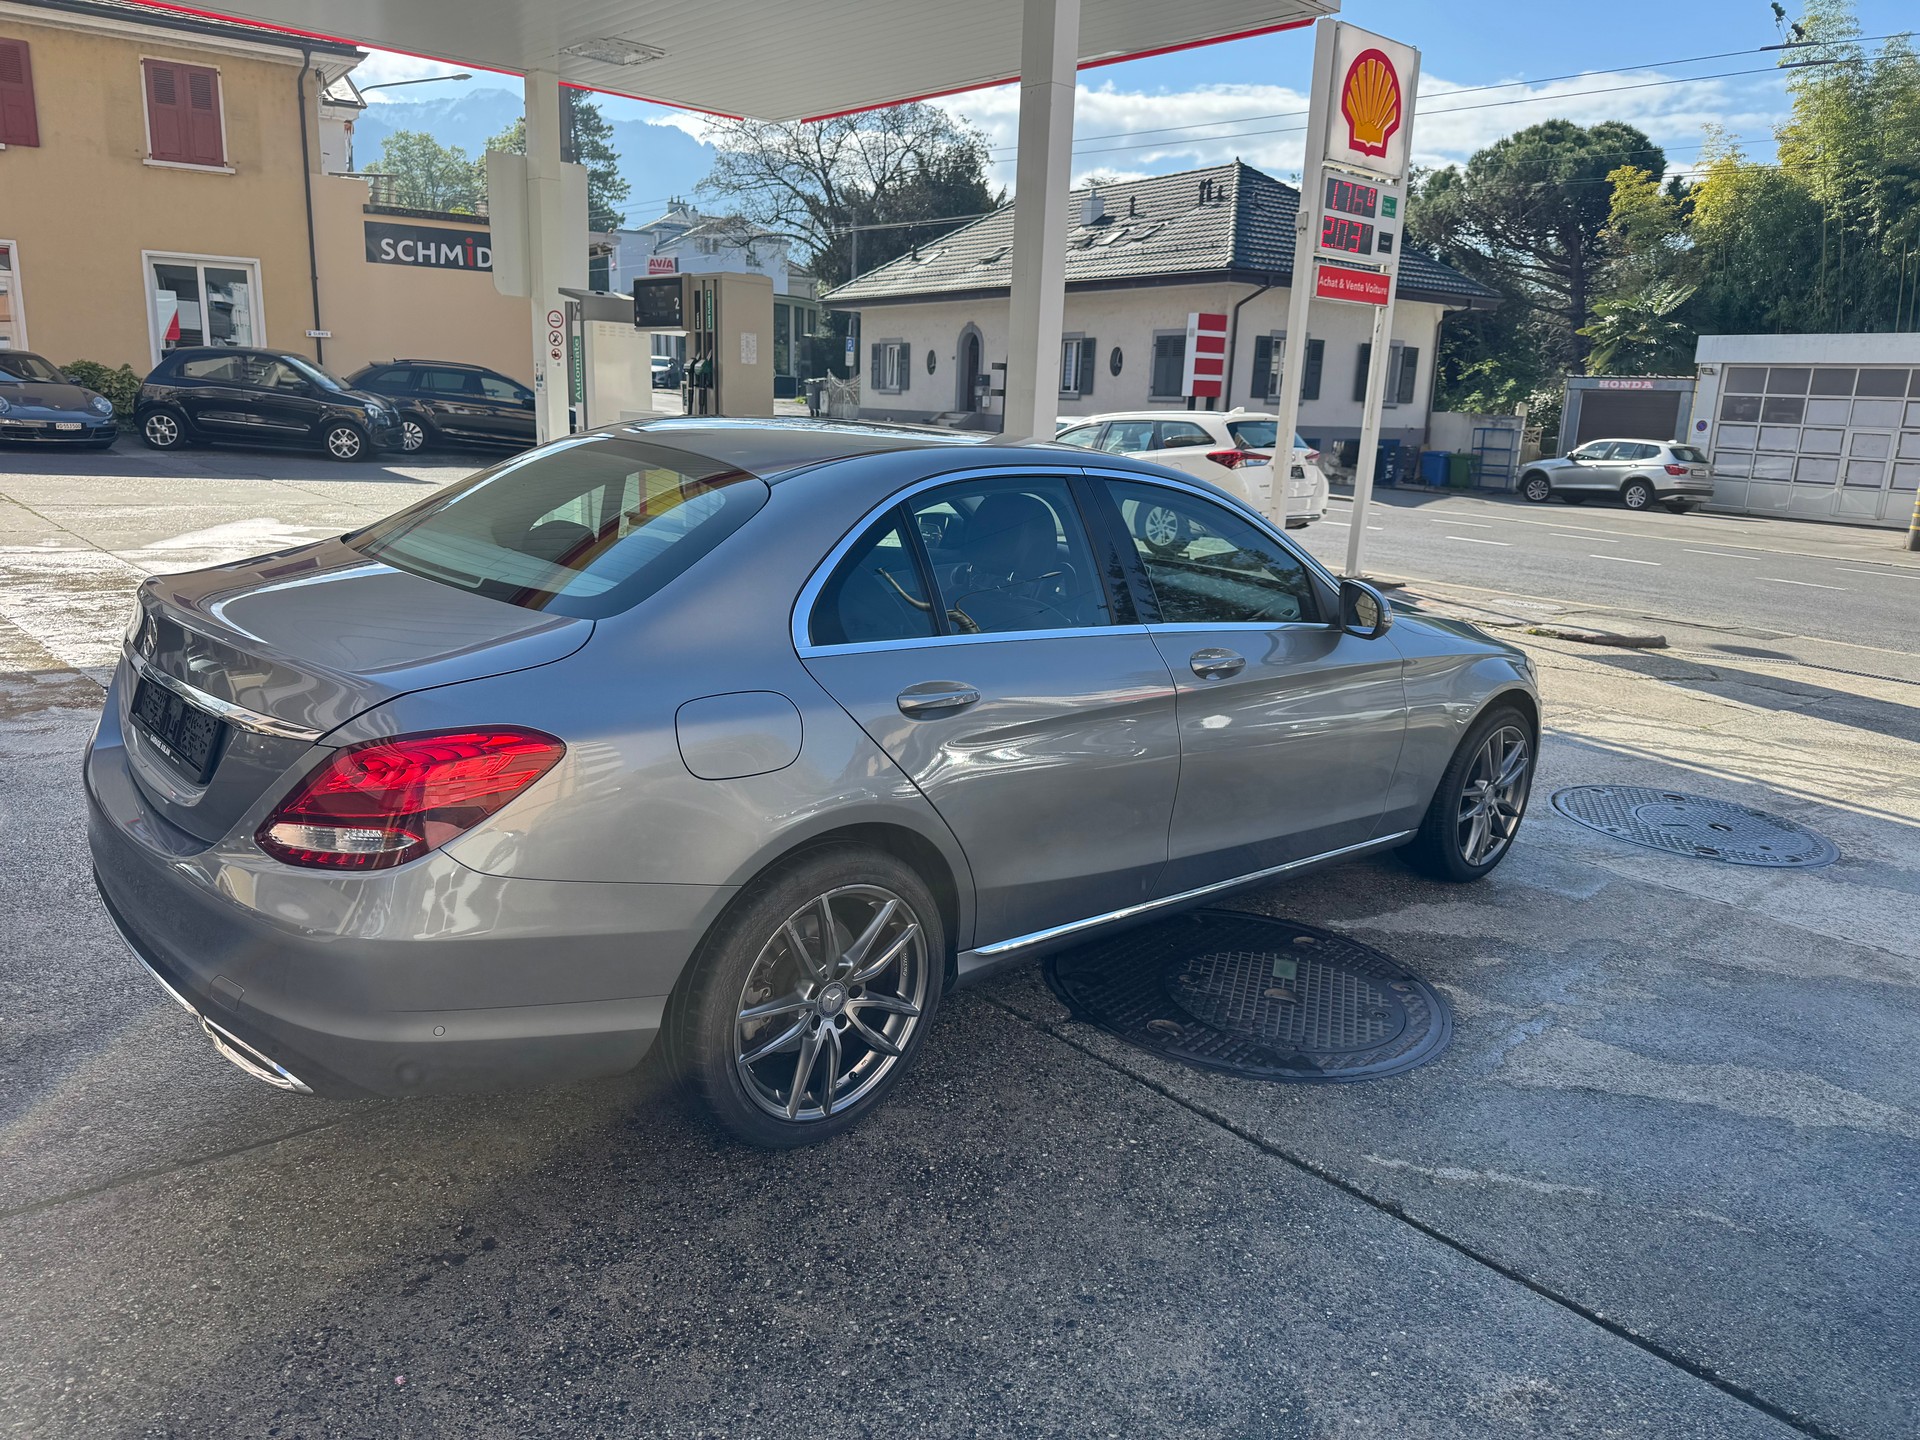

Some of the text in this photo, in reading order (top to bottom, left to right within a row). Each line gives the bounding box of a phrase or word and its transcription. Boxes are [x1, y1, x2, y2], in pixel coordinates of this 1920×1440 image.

[1318, 276, 1388, 295] Achat & Vente Voiture
[673, 297, 680, 310] 2
[574, 338, 582, 400] Automate
[1598, 380, 1654, 389] HONDA
